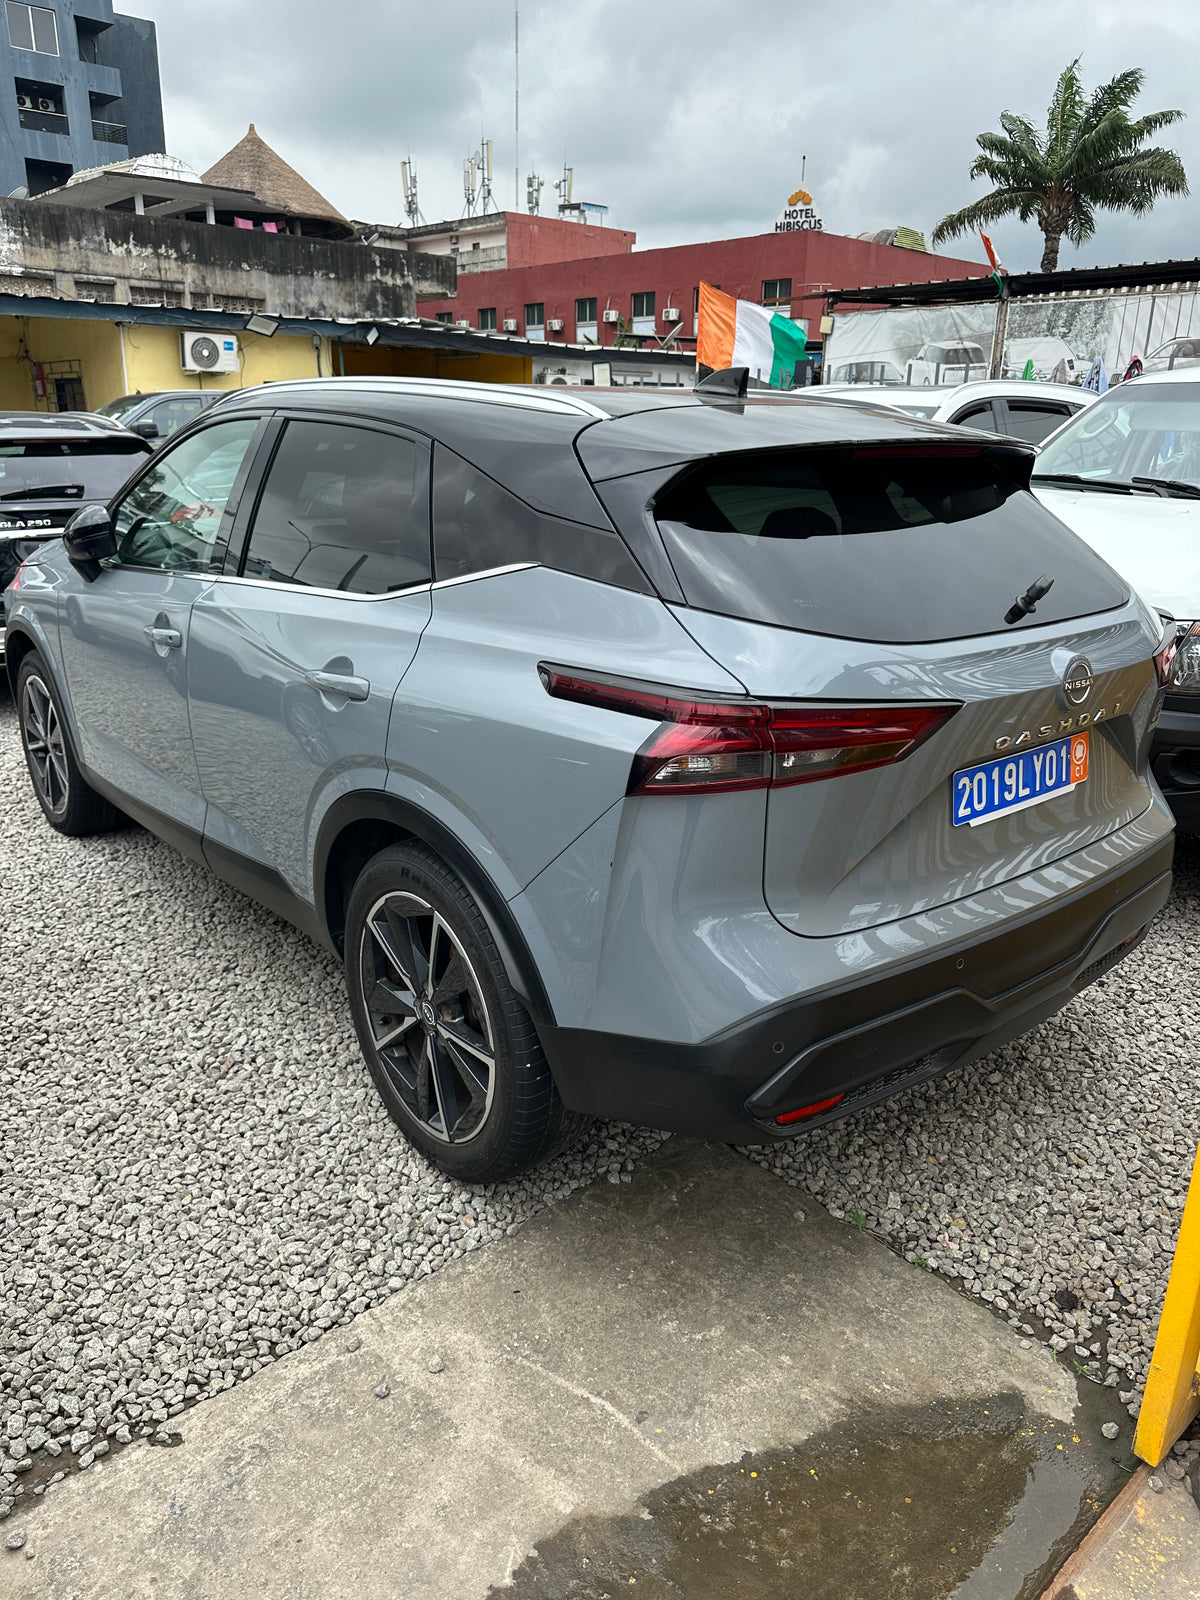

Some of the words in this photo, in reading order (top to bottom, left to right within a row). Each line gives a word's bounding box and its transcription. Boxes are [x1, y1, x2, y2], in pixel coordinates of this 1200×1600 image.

[784, 208, 816, 220] HOTEL
[775, 219, 823, 232] HIBISCUS
[27, 519, 51, 527] 250
